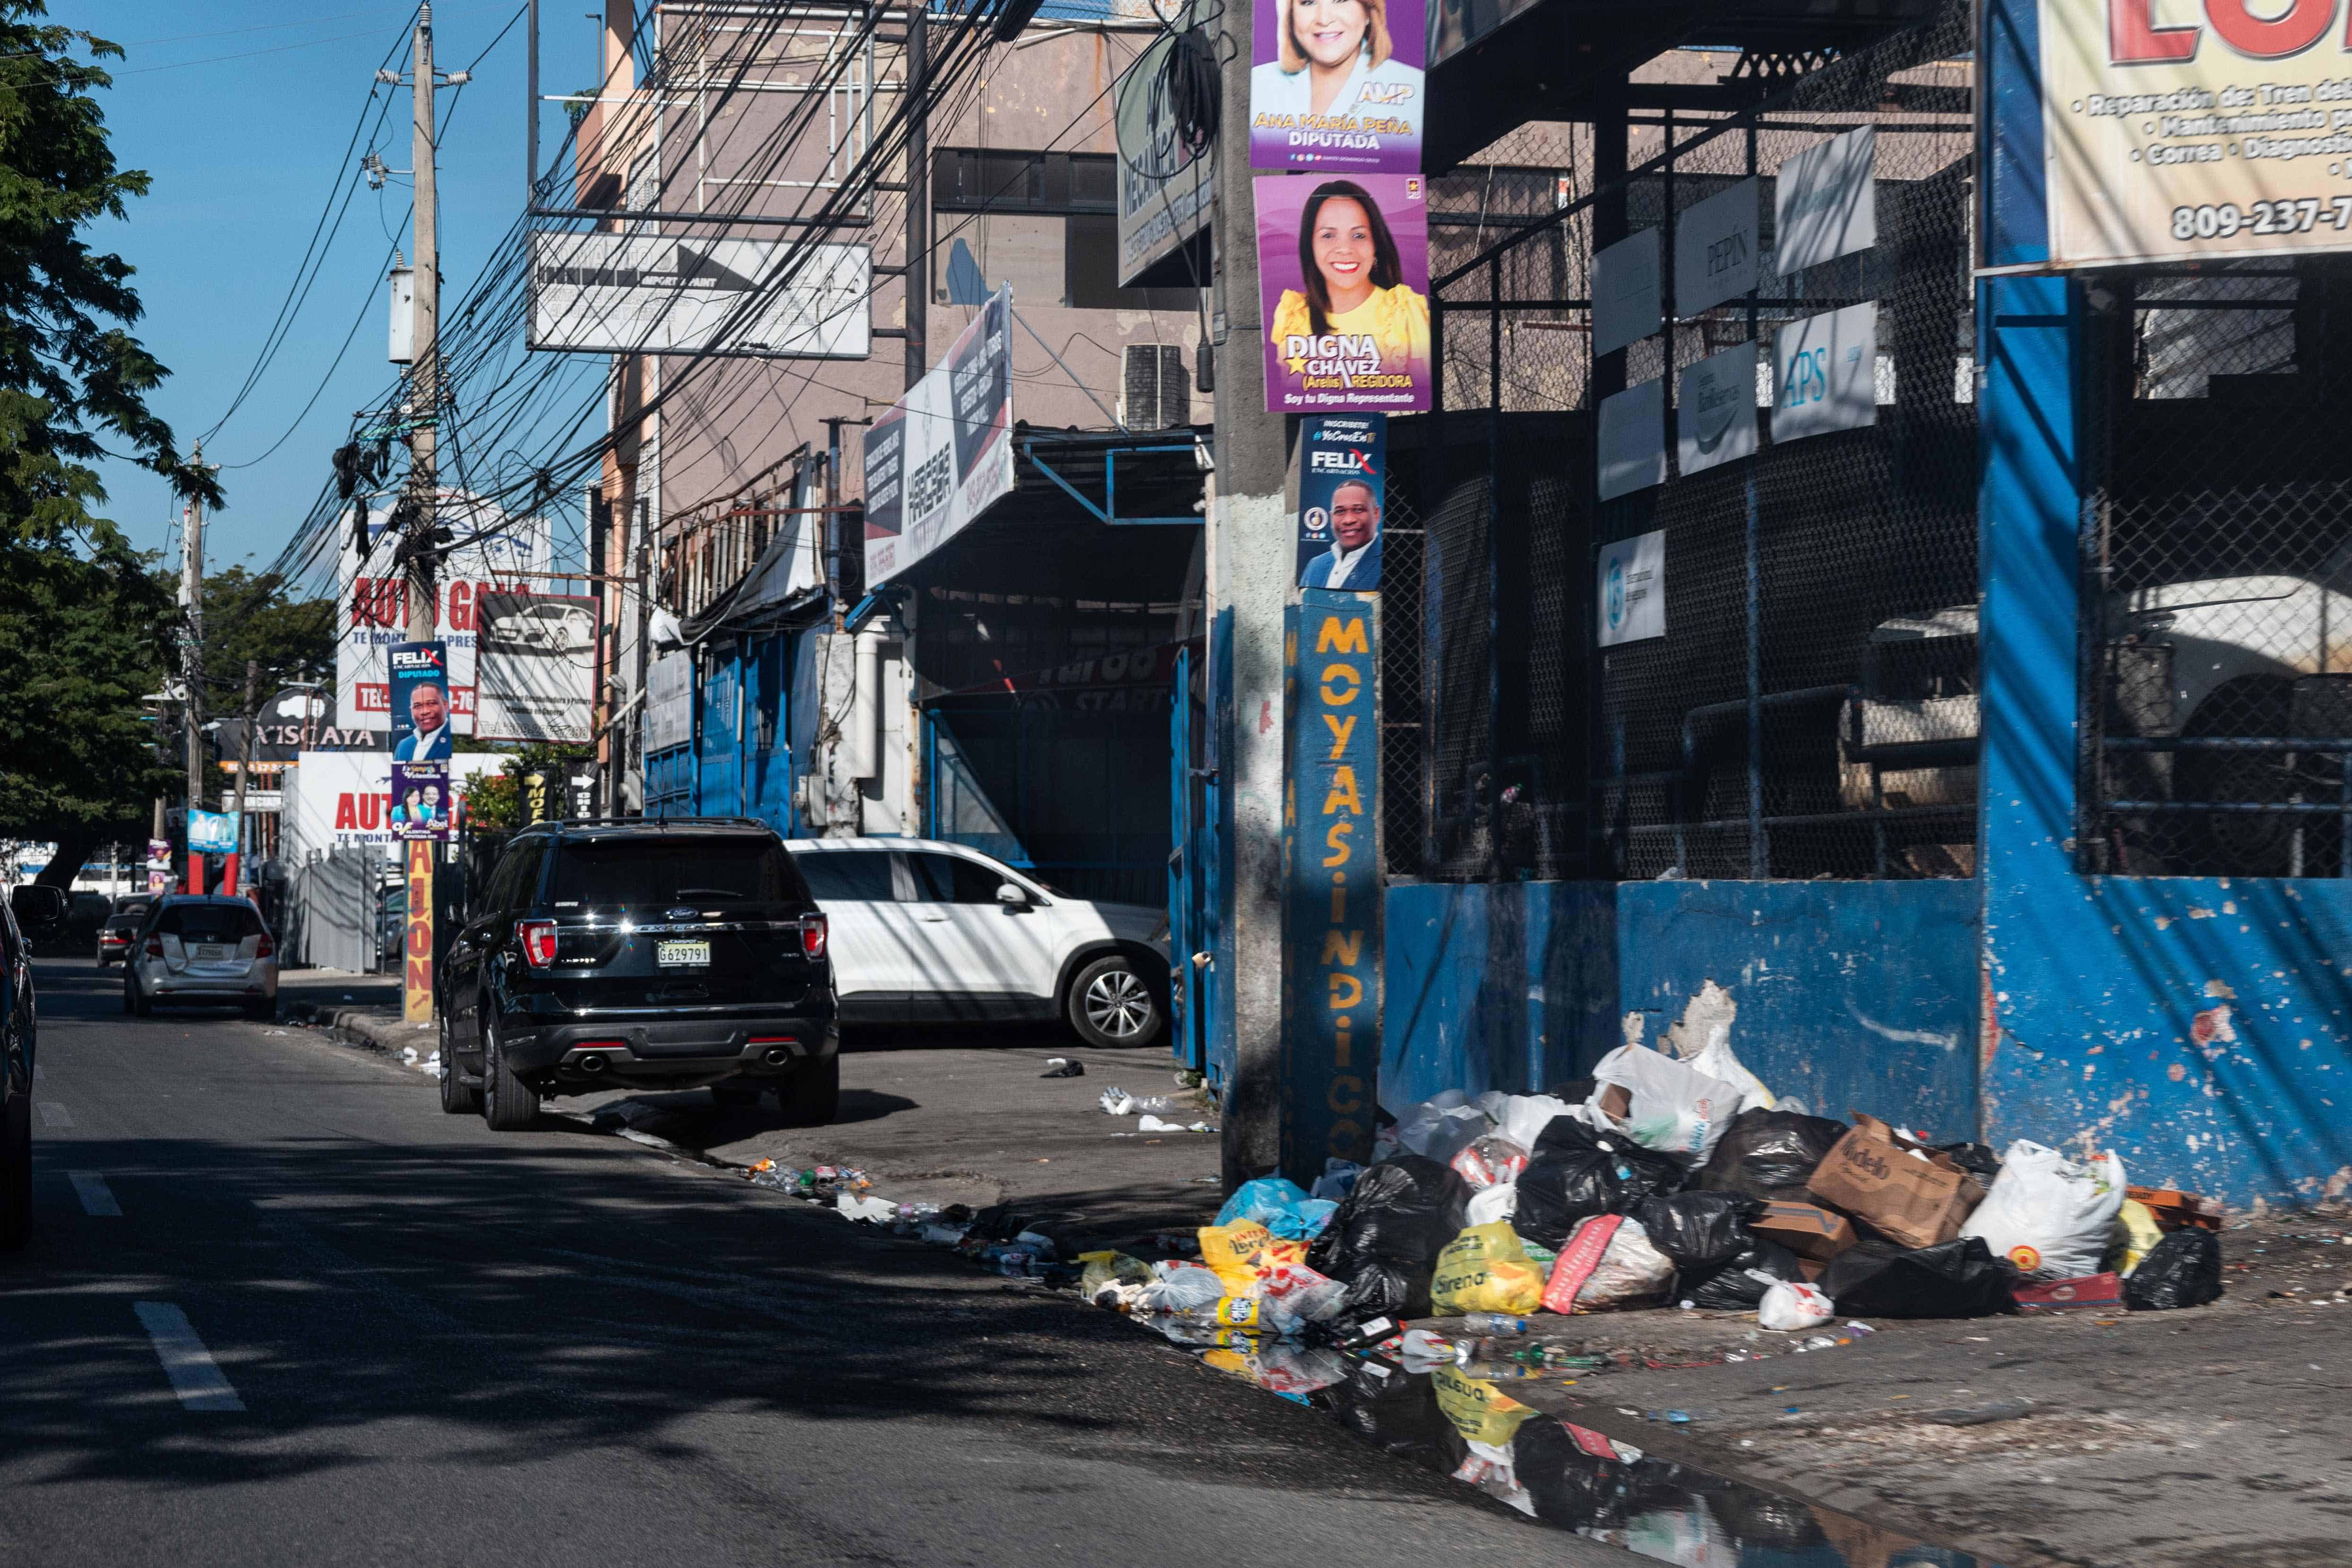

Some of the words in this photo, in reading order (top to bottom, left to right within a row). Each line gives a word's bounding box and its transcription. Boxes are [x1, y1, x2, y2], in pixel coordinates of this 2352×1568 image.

[1356, 81, 1416, 105] AMP
[2087, 87, 2215, 118] Reparación
[2261, 83, 2310, 104] Tren
[1253, 112, 1296, 129] ANA
[1300, 113, 1361, 132] MARÍA
[1363, 117, 1413, 136] PEÑA
[2160, 109, 2326, 138] Mantenimiento
[1288, 130, 1381, 150] DIPUTADA
[2146, 142, 2223, 166] Correa
[1286, 334, 1382, 360] DIGNA
[1307, 357, 1381, 376] CHÁVEZ
[1351, 375, 1414, 389] REGIDORA
[1284, 393, 1304, 405] Soy
[1305, 394, 1316, 403] tu
[1317, 393, 1345, 405] Digna
[1346, 393, 1415, 405] Representante
[1311, 448, 1376, 474] FELIX
[353, 632, 367, 644] TE
[392, 647, 444, 666] FELIX
[398, 669, 440, 679] DIPUTADO
[660, 948, 707, 961] G629791
